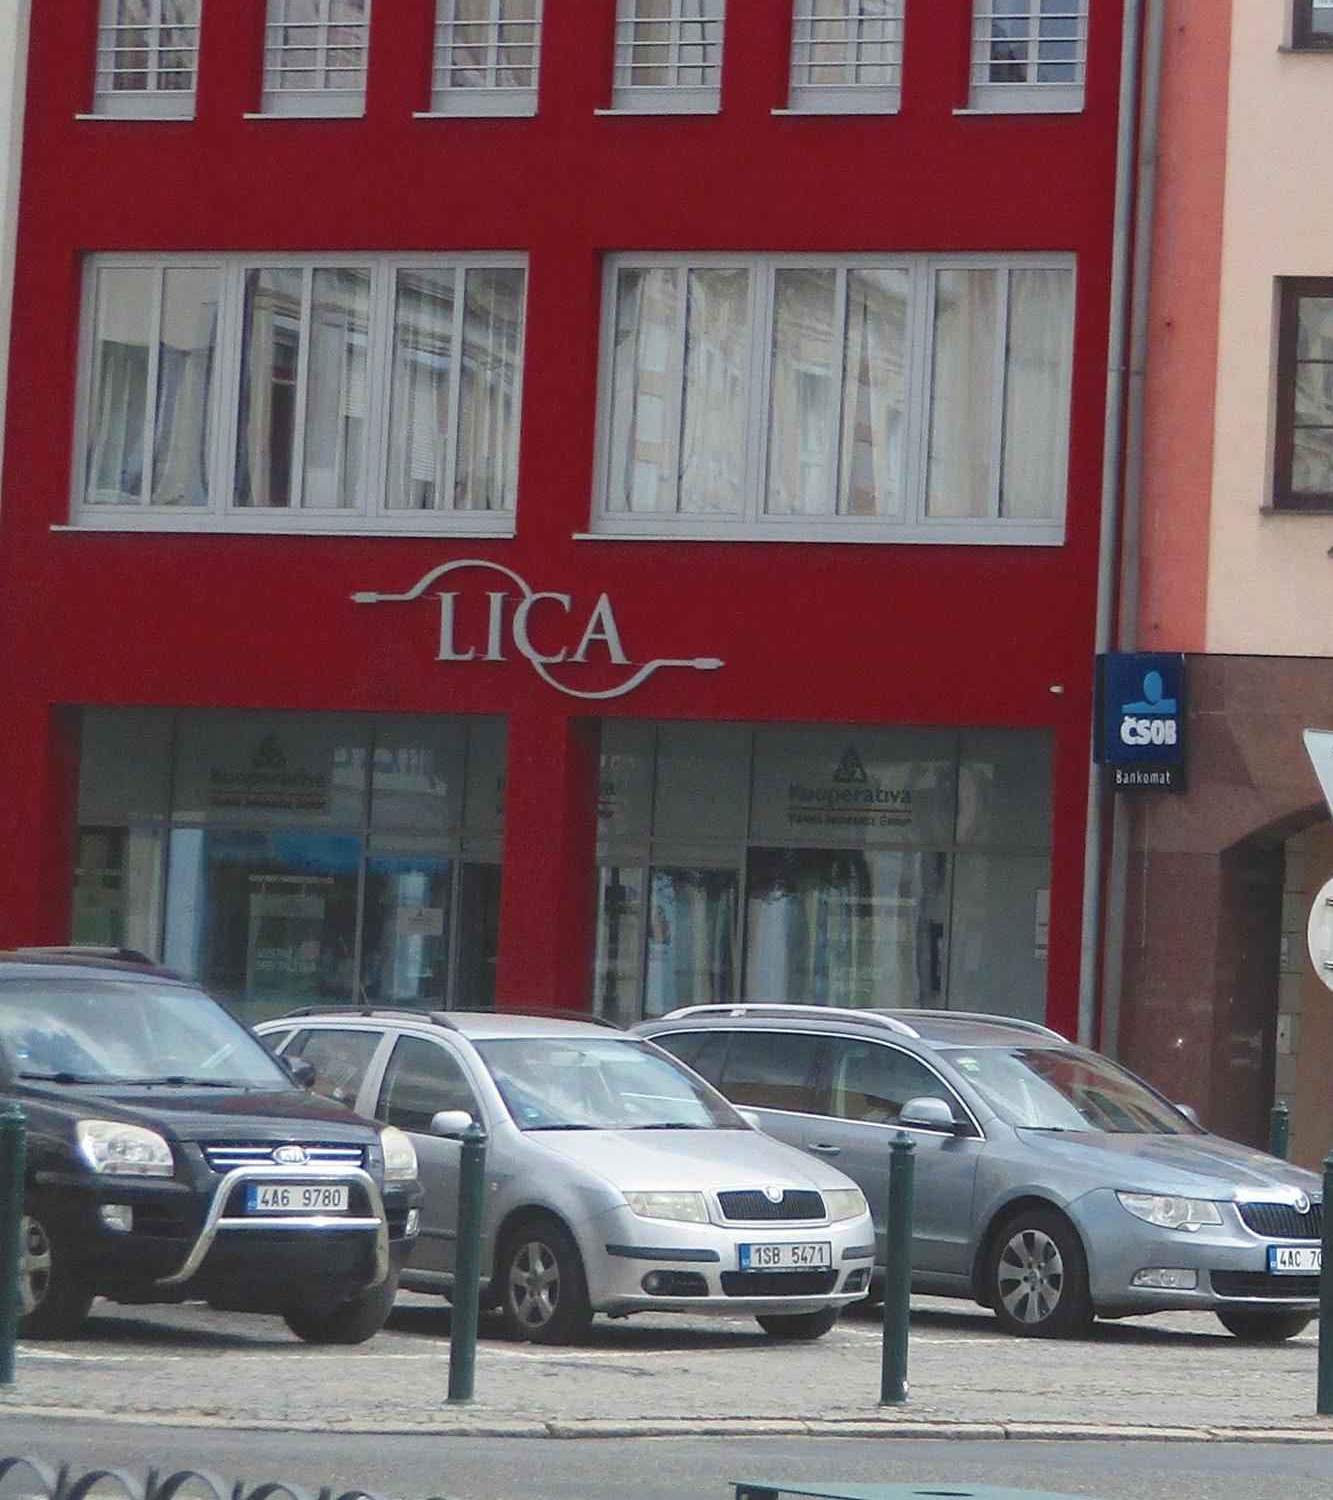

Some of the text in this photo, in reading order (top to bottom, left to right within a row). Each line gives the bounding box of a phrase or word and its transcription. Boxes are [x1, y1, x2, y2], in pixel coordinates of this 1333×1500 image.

[435, 591, 633, 665] LICA
[1120, 715, 1177, 745] ČSOB
[1115, 769, 1171, 784] Bankomat
[261, 1189, 290, 1207] 4A6
[303, 1188, 341, 1207] 9780
[755, 1245, 824, 1264] 1SB 5471
[1279, 1250, 1302, 1267] 4AC
